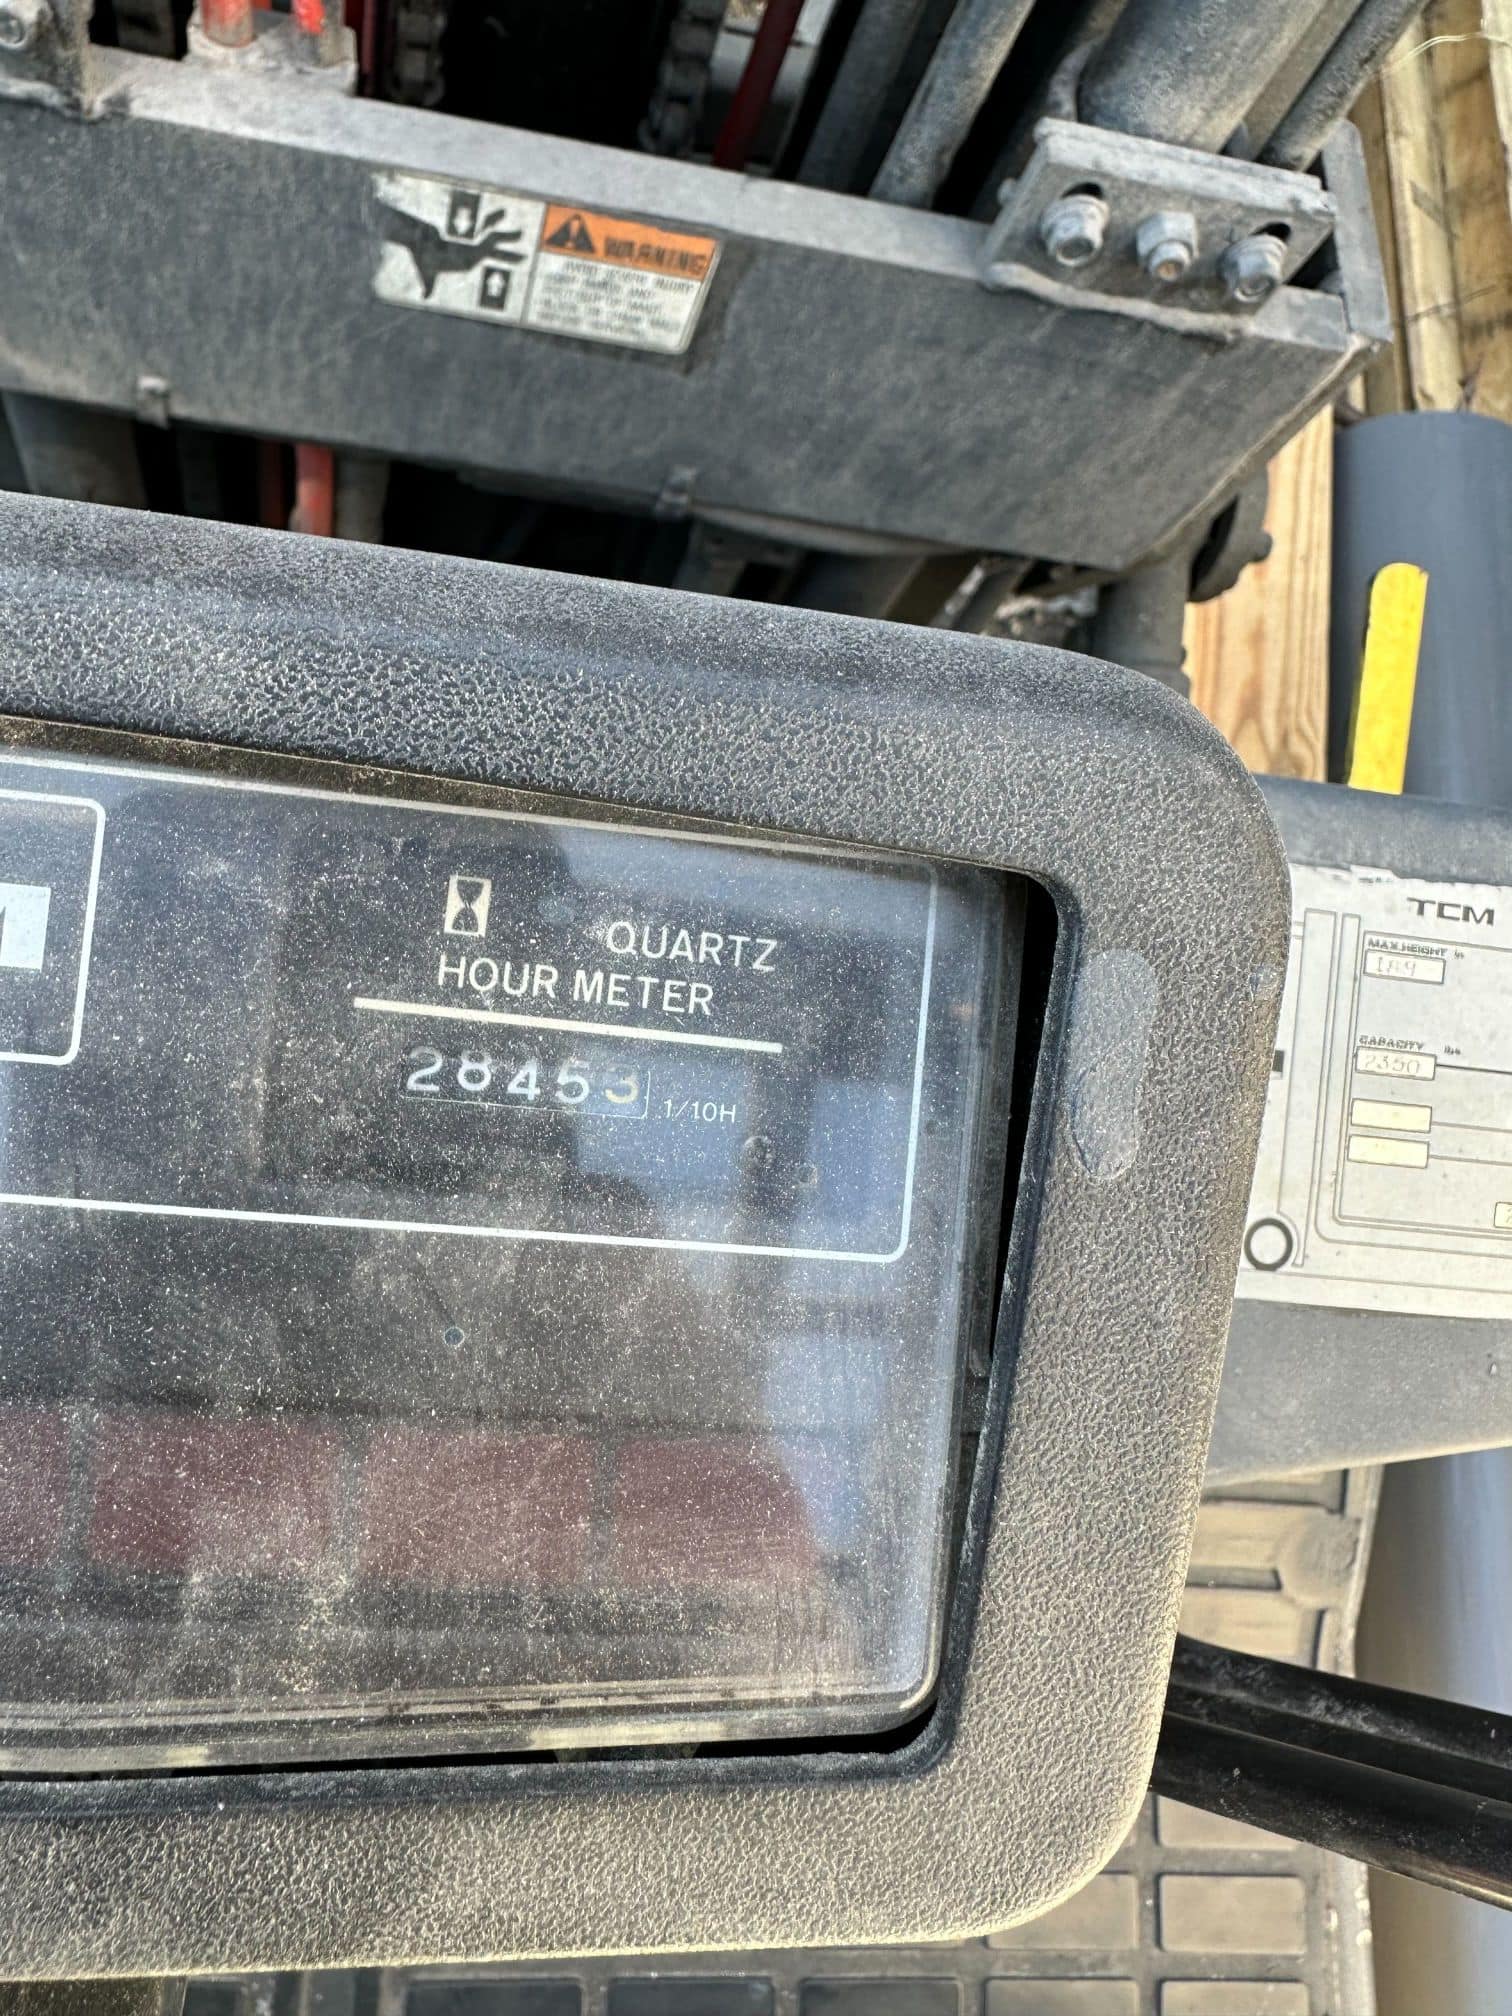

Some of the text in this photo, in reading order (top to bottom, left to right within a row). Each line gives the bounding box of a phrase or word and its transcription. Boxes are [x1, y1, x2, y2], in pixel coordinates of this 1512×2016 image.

[605, 237, 708, 274] WARNING
[1406, 897, 1495, 926] TCM
[605, 920, 778, 971] QUARTZ
[438, 954, 714, 1016] HOUR METER
[1359, 1034, 1425, 1050] CAPACITY
[1364, 1054, 1421, 1075] 2350
[405, 1046, 737, 1124] 28453 1/10H
